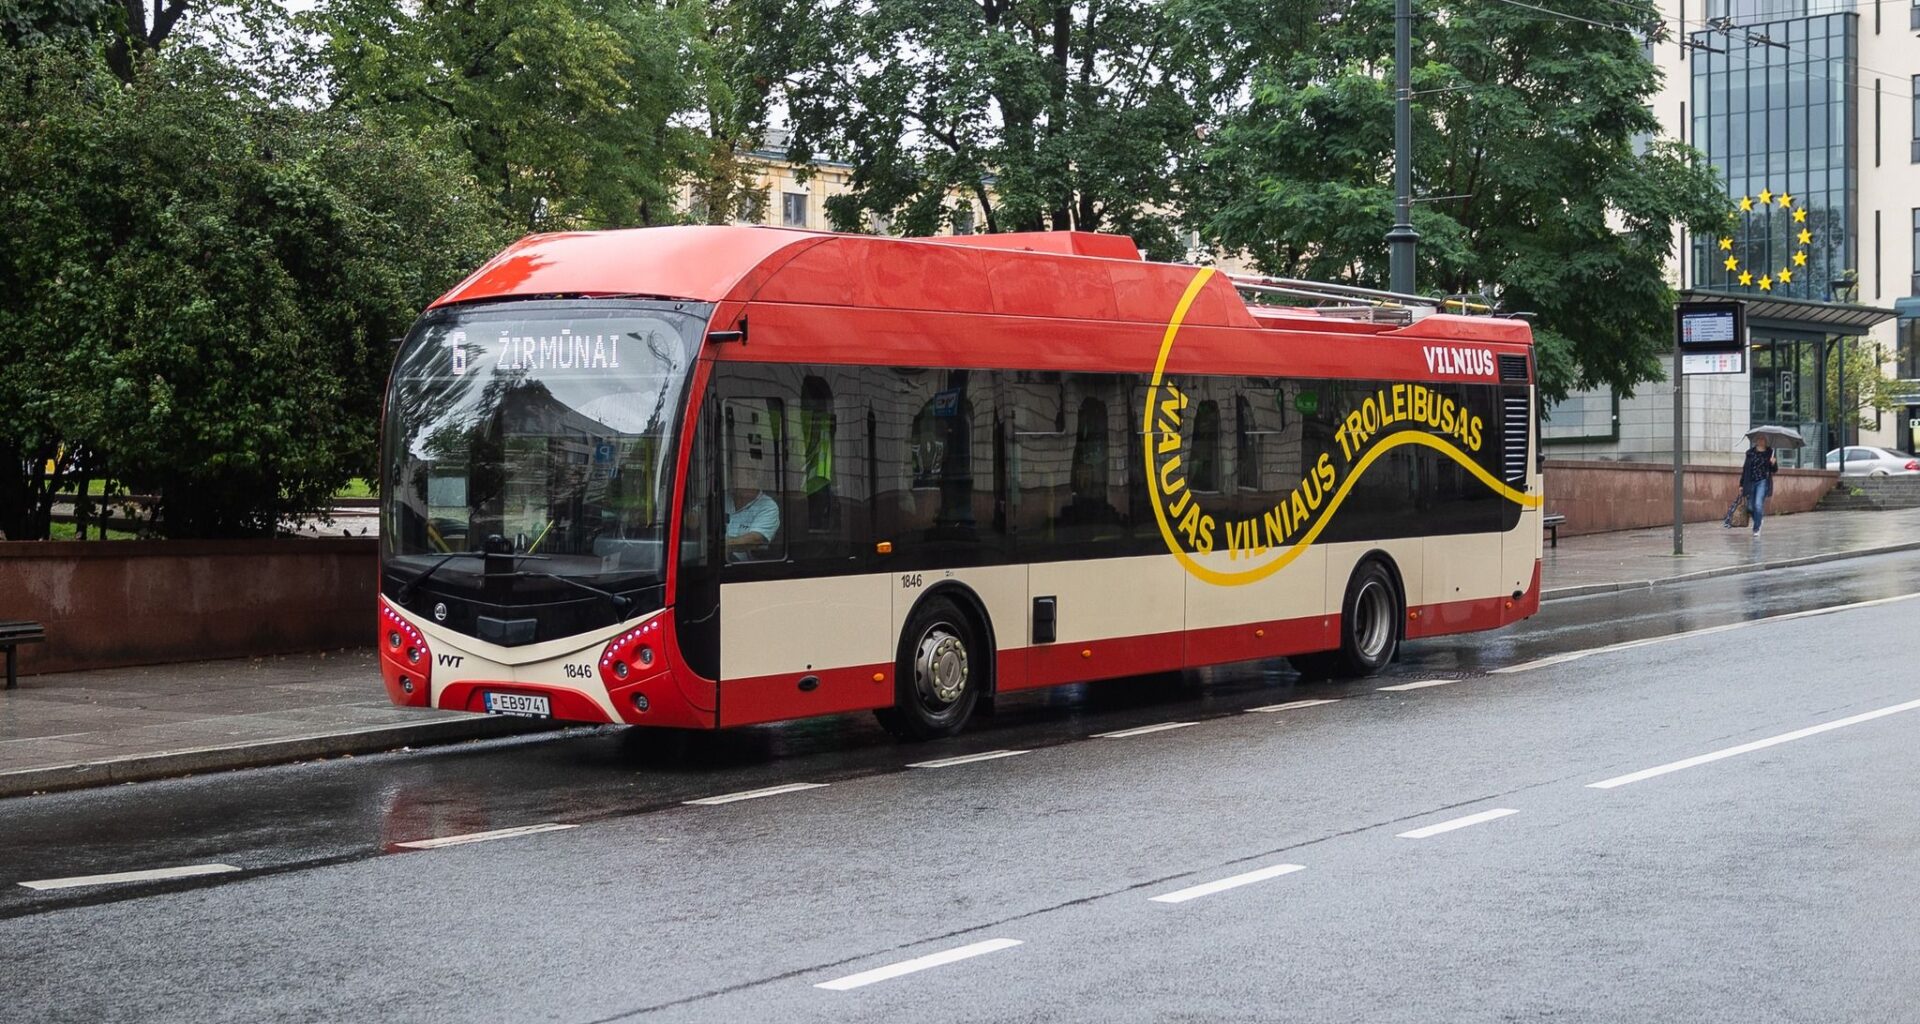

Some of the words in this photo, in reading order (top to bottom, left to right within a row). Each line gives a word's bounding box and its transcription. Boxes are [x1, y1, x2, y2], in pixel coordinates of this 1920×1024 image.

[452, 331, 467, 375] 6
[497, 329, 620, 370] ŽIRMŪNAI
[1423, 346, 1494, 375] VILNIUS
[1158, 381, 1215, 555] NAUJAS
[1226, 453, 1336, 560] VILNIAUS
[1335, 384, 1483, 462] TROLEIBUSAS
[901, 574, 923, 588] 1846
[438, 653, 463, 668] VVT
[563, 663, 593, 679] 1846
[500, 696, 545, 712] EB9741
